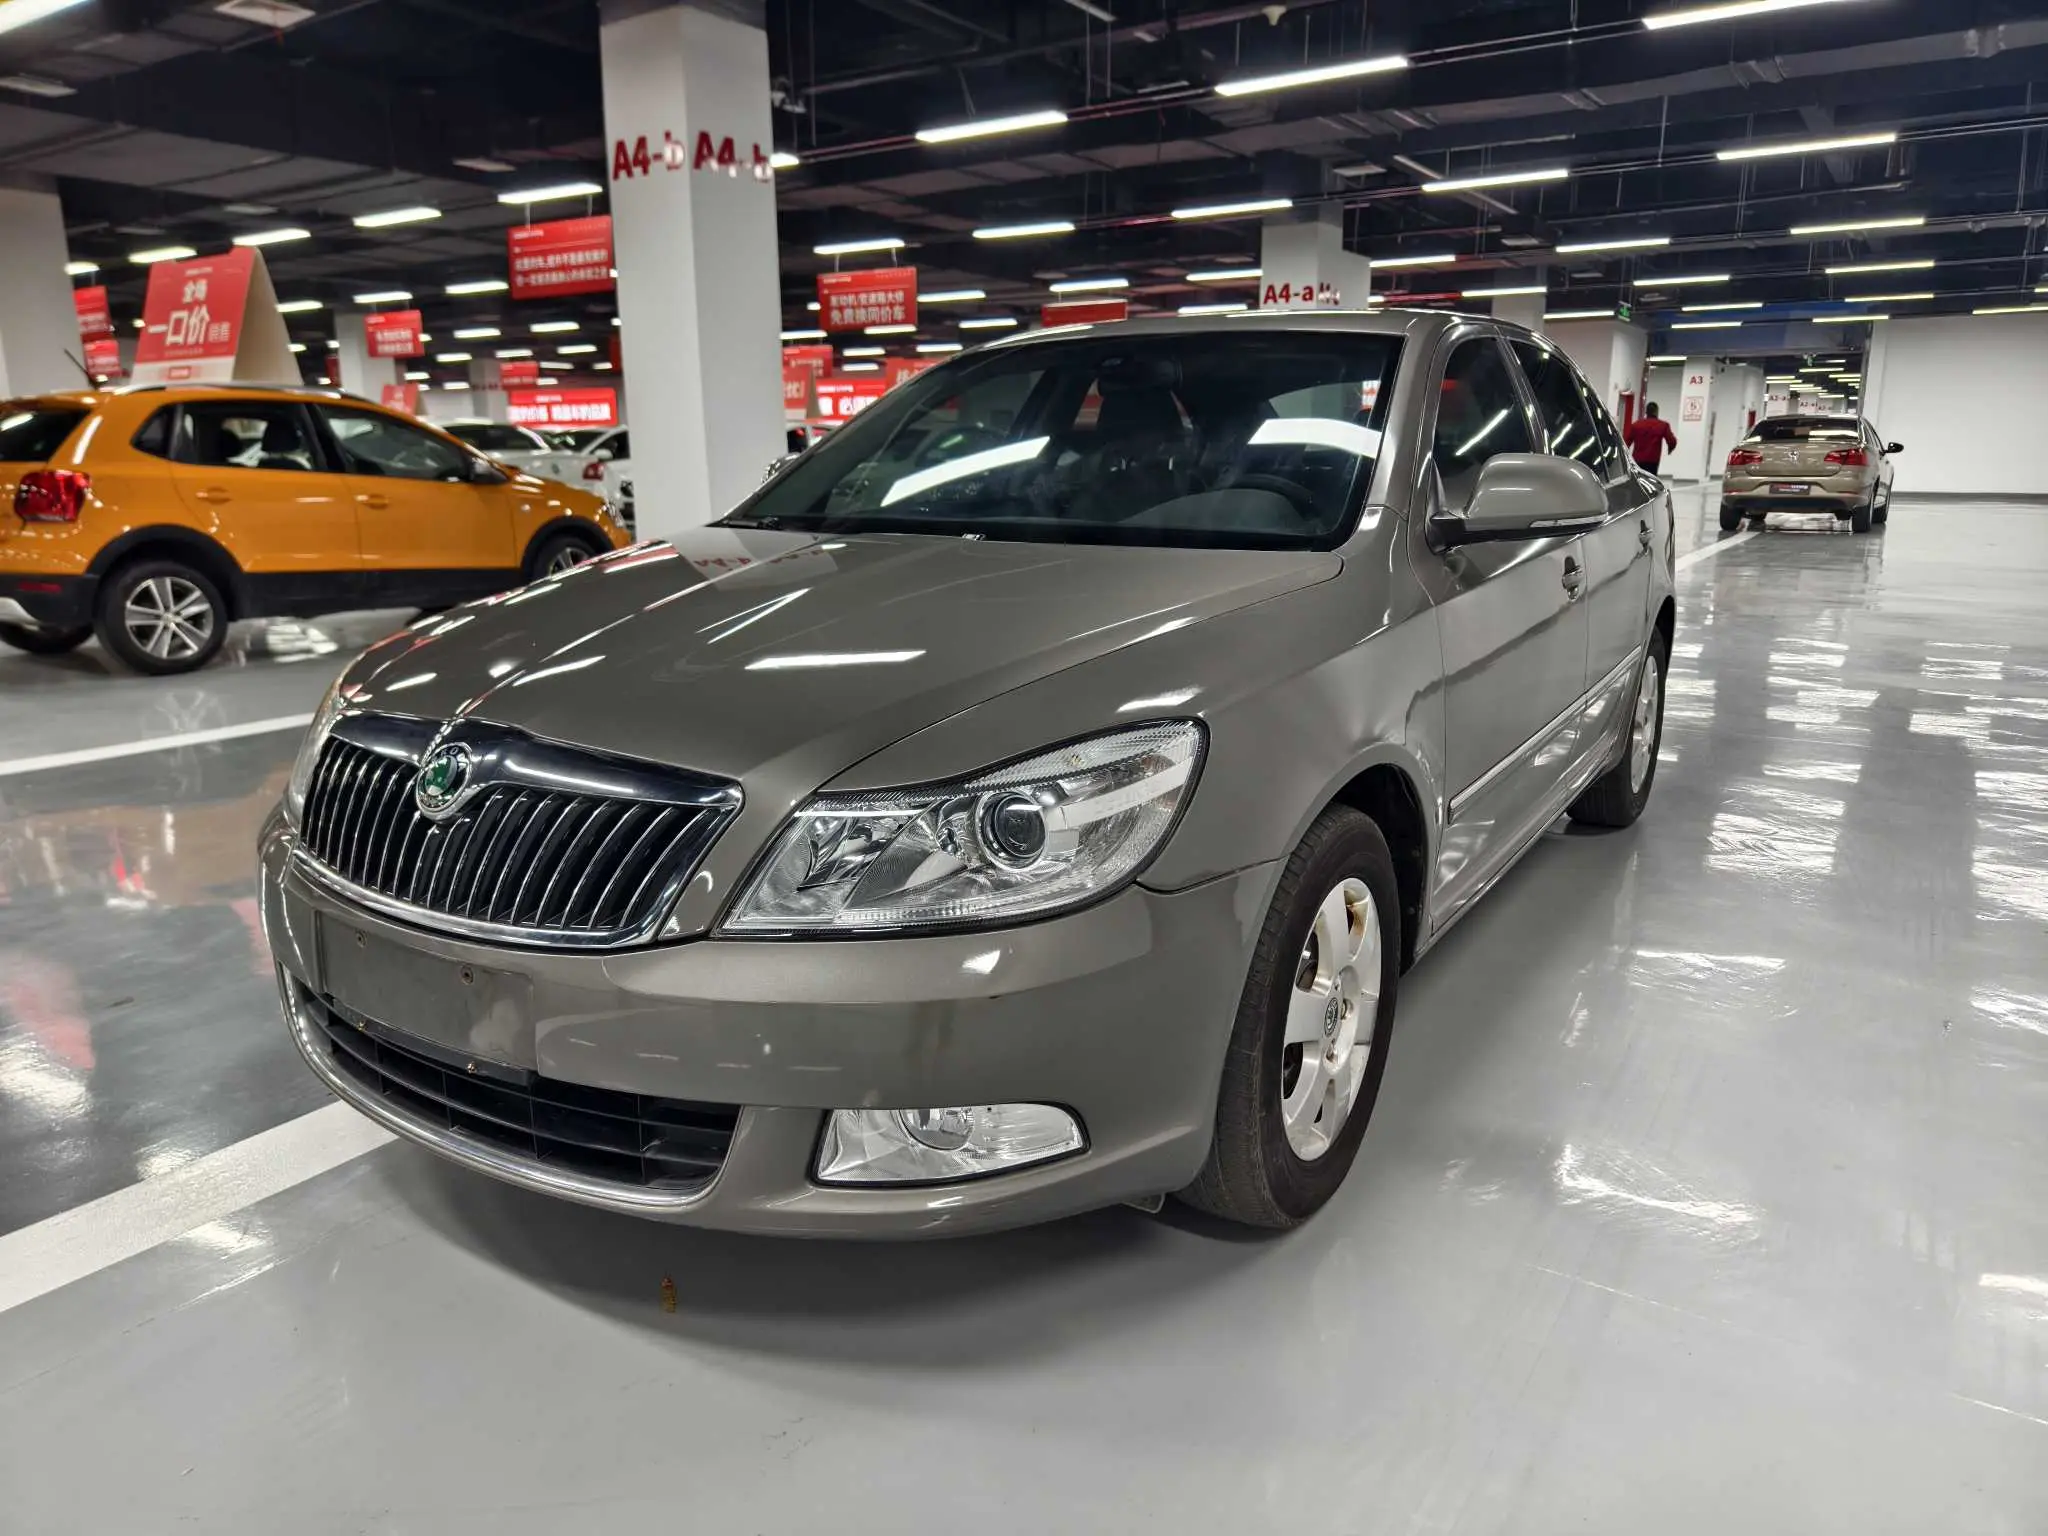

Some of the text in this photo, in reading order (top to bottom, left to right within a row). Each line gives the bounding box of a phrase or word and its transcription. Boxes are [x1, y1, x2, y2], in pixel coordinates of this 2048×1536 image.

[612, 130, 685, 181] A4-b
[1263, 281, 1314, 305] A4-a
[147, 303, 211, 347] 一口价
[1689, 375, 1704, 385] A3
